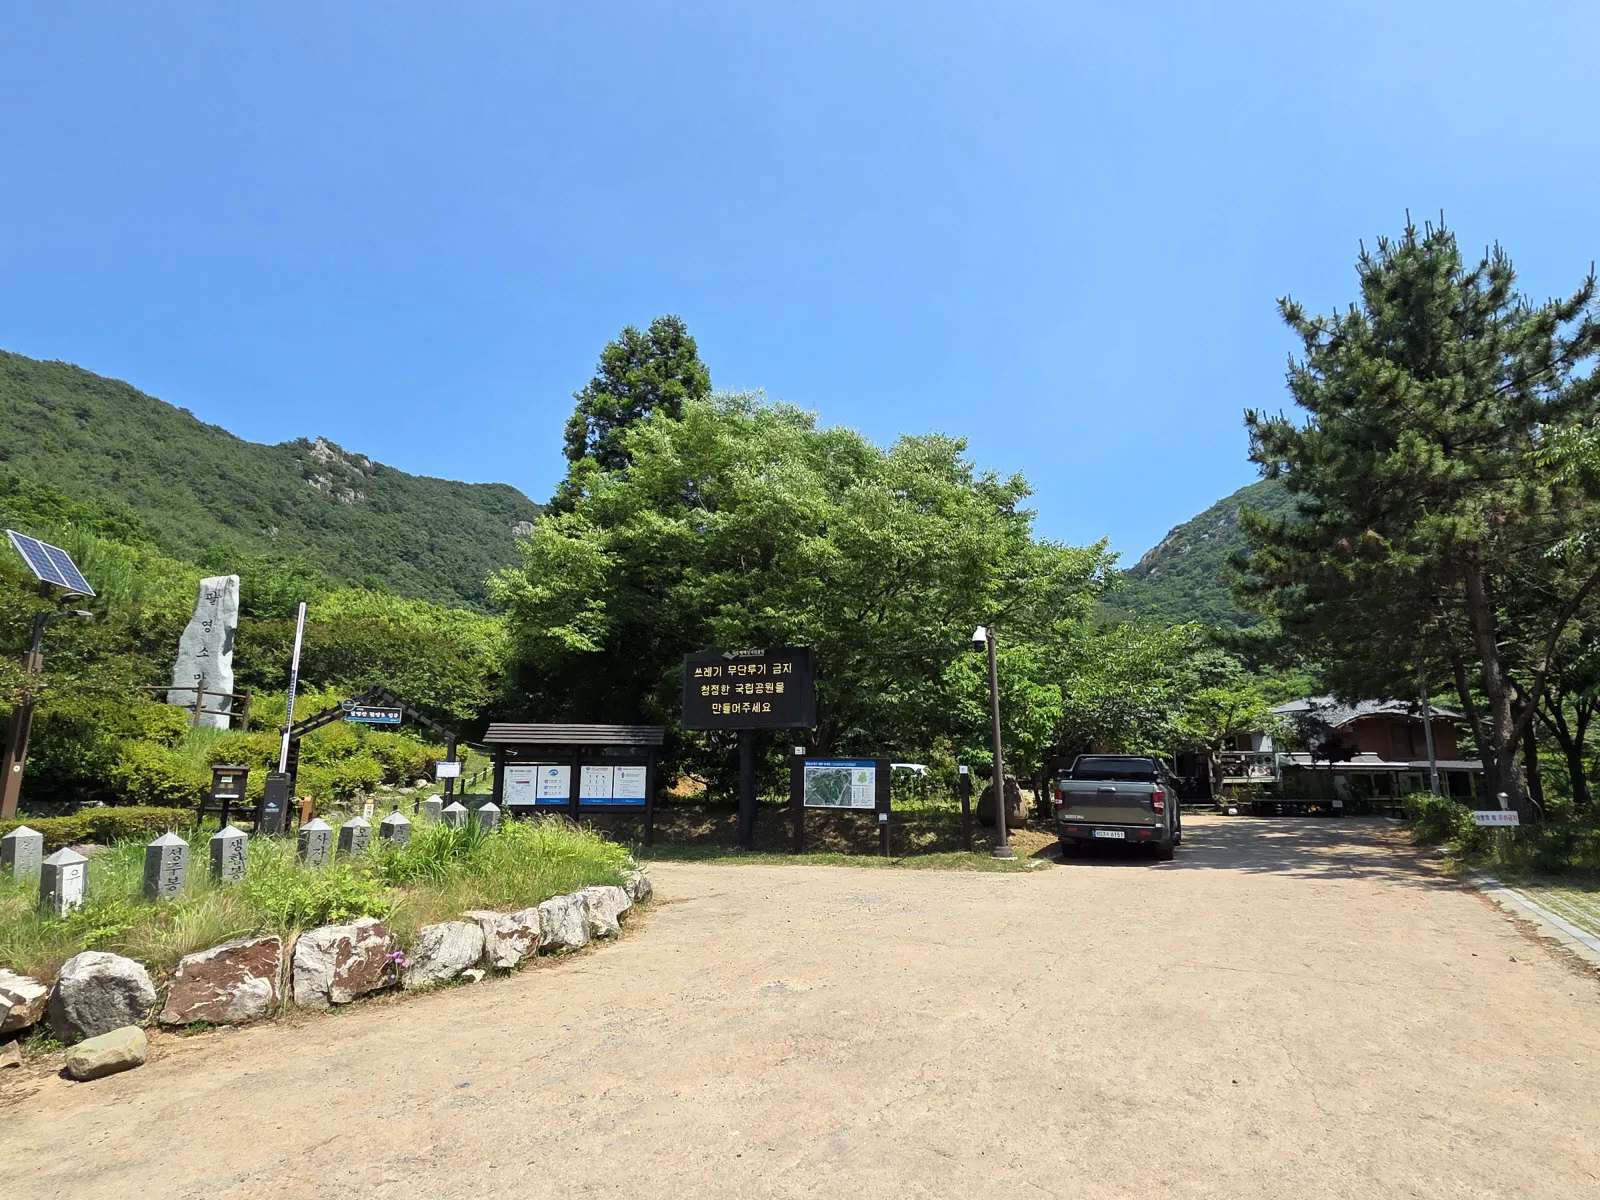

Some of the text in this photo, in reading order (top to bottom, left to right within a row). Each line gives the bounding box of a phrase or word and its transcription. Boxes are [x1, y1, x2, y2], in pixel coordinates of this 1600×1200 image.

[693, 662, 792, 678] 쓰레기 무단투기 금지
[700, 681, 785, 696] 청정한 국립공원을
[711, 702, 772, 715] 만들어주세요
[164, 846, 183, 892] 성주봉
